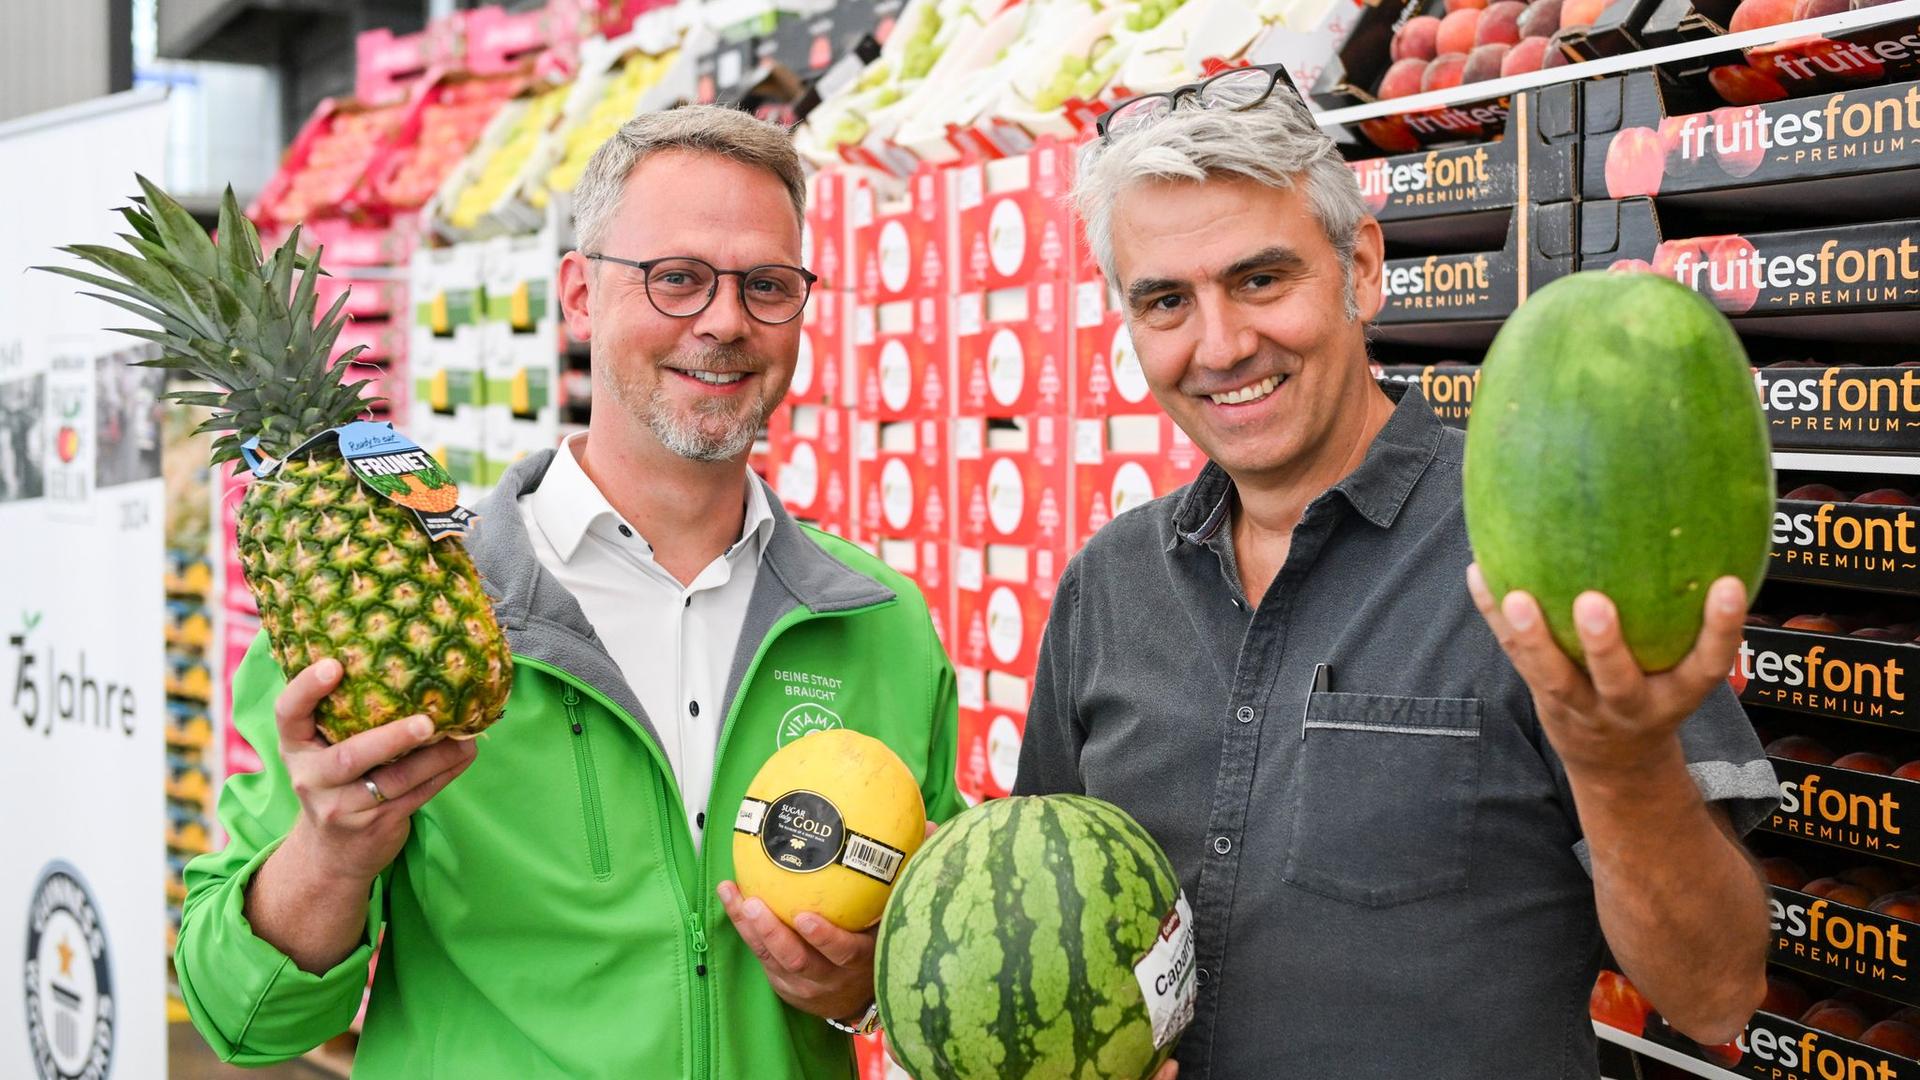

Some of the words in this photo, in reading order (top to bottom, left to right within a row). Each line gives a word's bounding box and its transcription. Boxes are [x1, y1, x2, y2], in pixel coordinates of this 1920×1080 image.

[1774, 25, 1920, 80] fruites
[1680, 86, 1920, 160] fruitesfont
[1673, 237, 1920, 292] fruitesfont
[353, 451, 434, 477] FRUNET
[9, 634, 39, 727] 75
[43, 645, 137, 737] Jahre
[774, 670, 810, 684] DEINE
[811, 674, 843, 688] STADT
[1730, 640, 1905, 700] tesfont
[785, 686, 836, 701] BRAUCHT
[781, 804, 806, 817] SUGAR
[793, 816, 832, 837] GOLD
